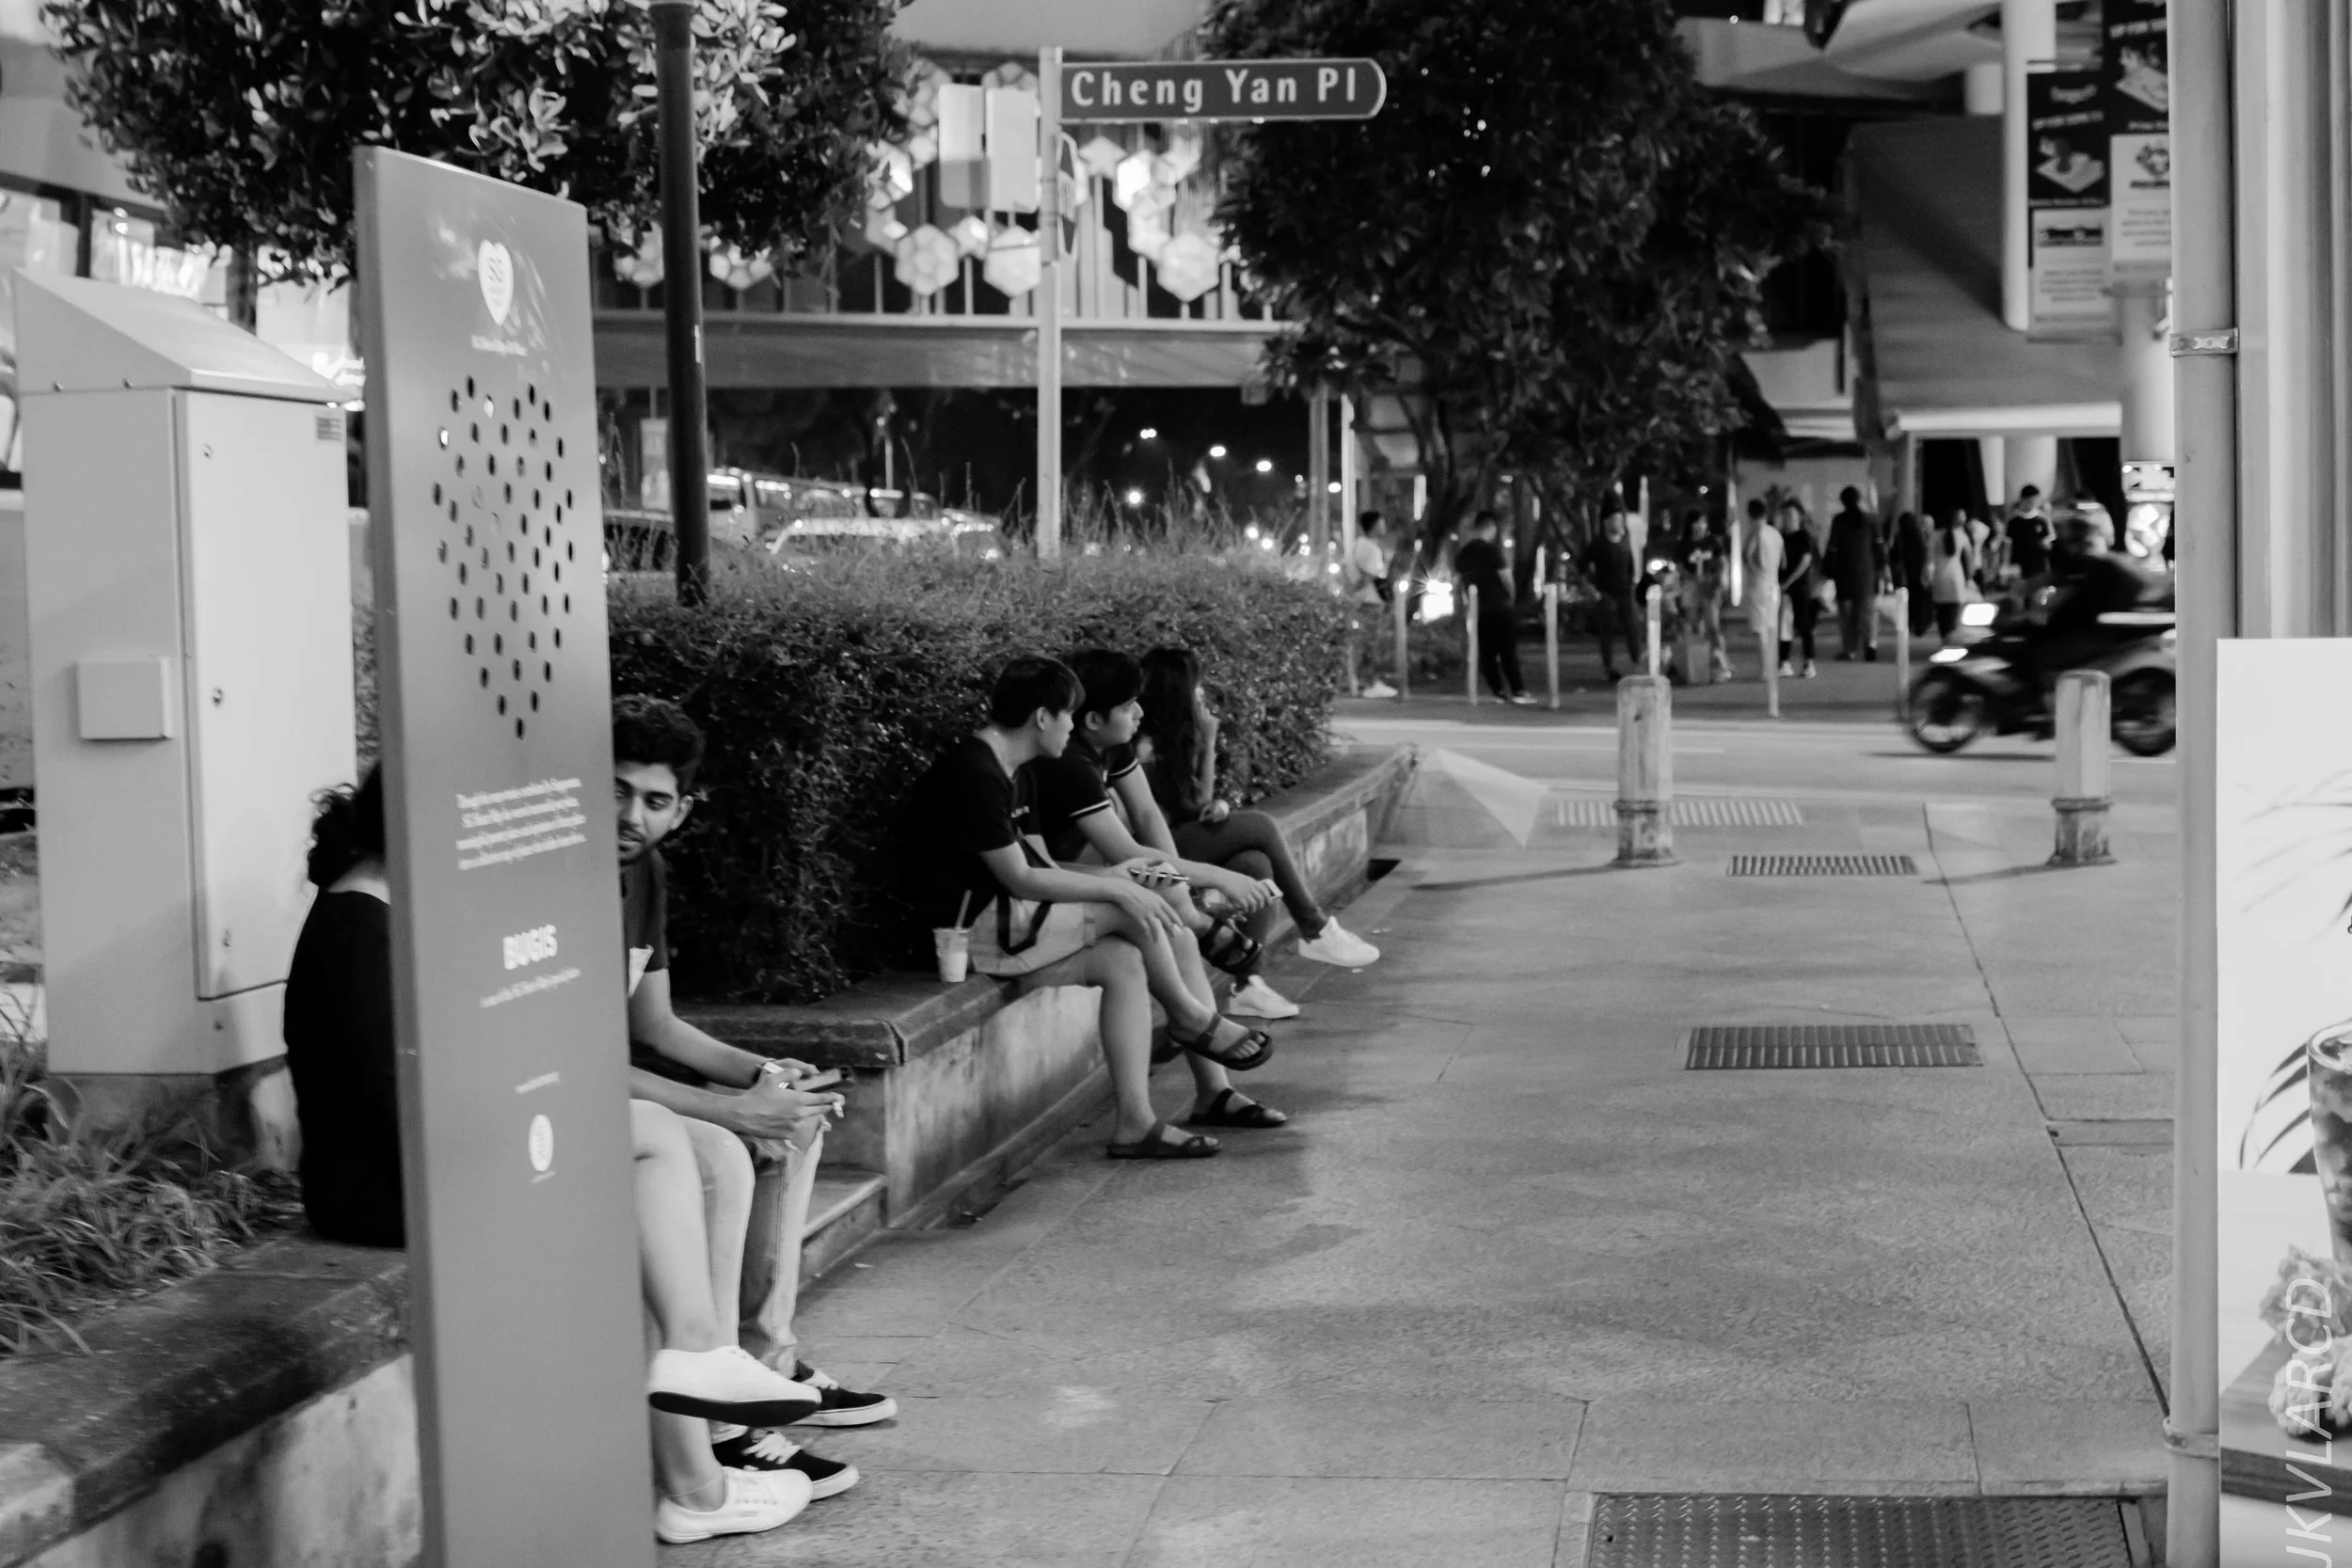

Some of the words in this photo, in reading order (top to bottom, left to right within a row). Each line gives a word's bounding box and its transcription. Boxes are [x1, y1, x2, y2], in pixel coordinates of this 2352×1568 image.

[1071, 70, 1203, 114] Cheng
[1225, 68, 1296, 103] Yan
[1317, 66, 1356, 103] Pl
